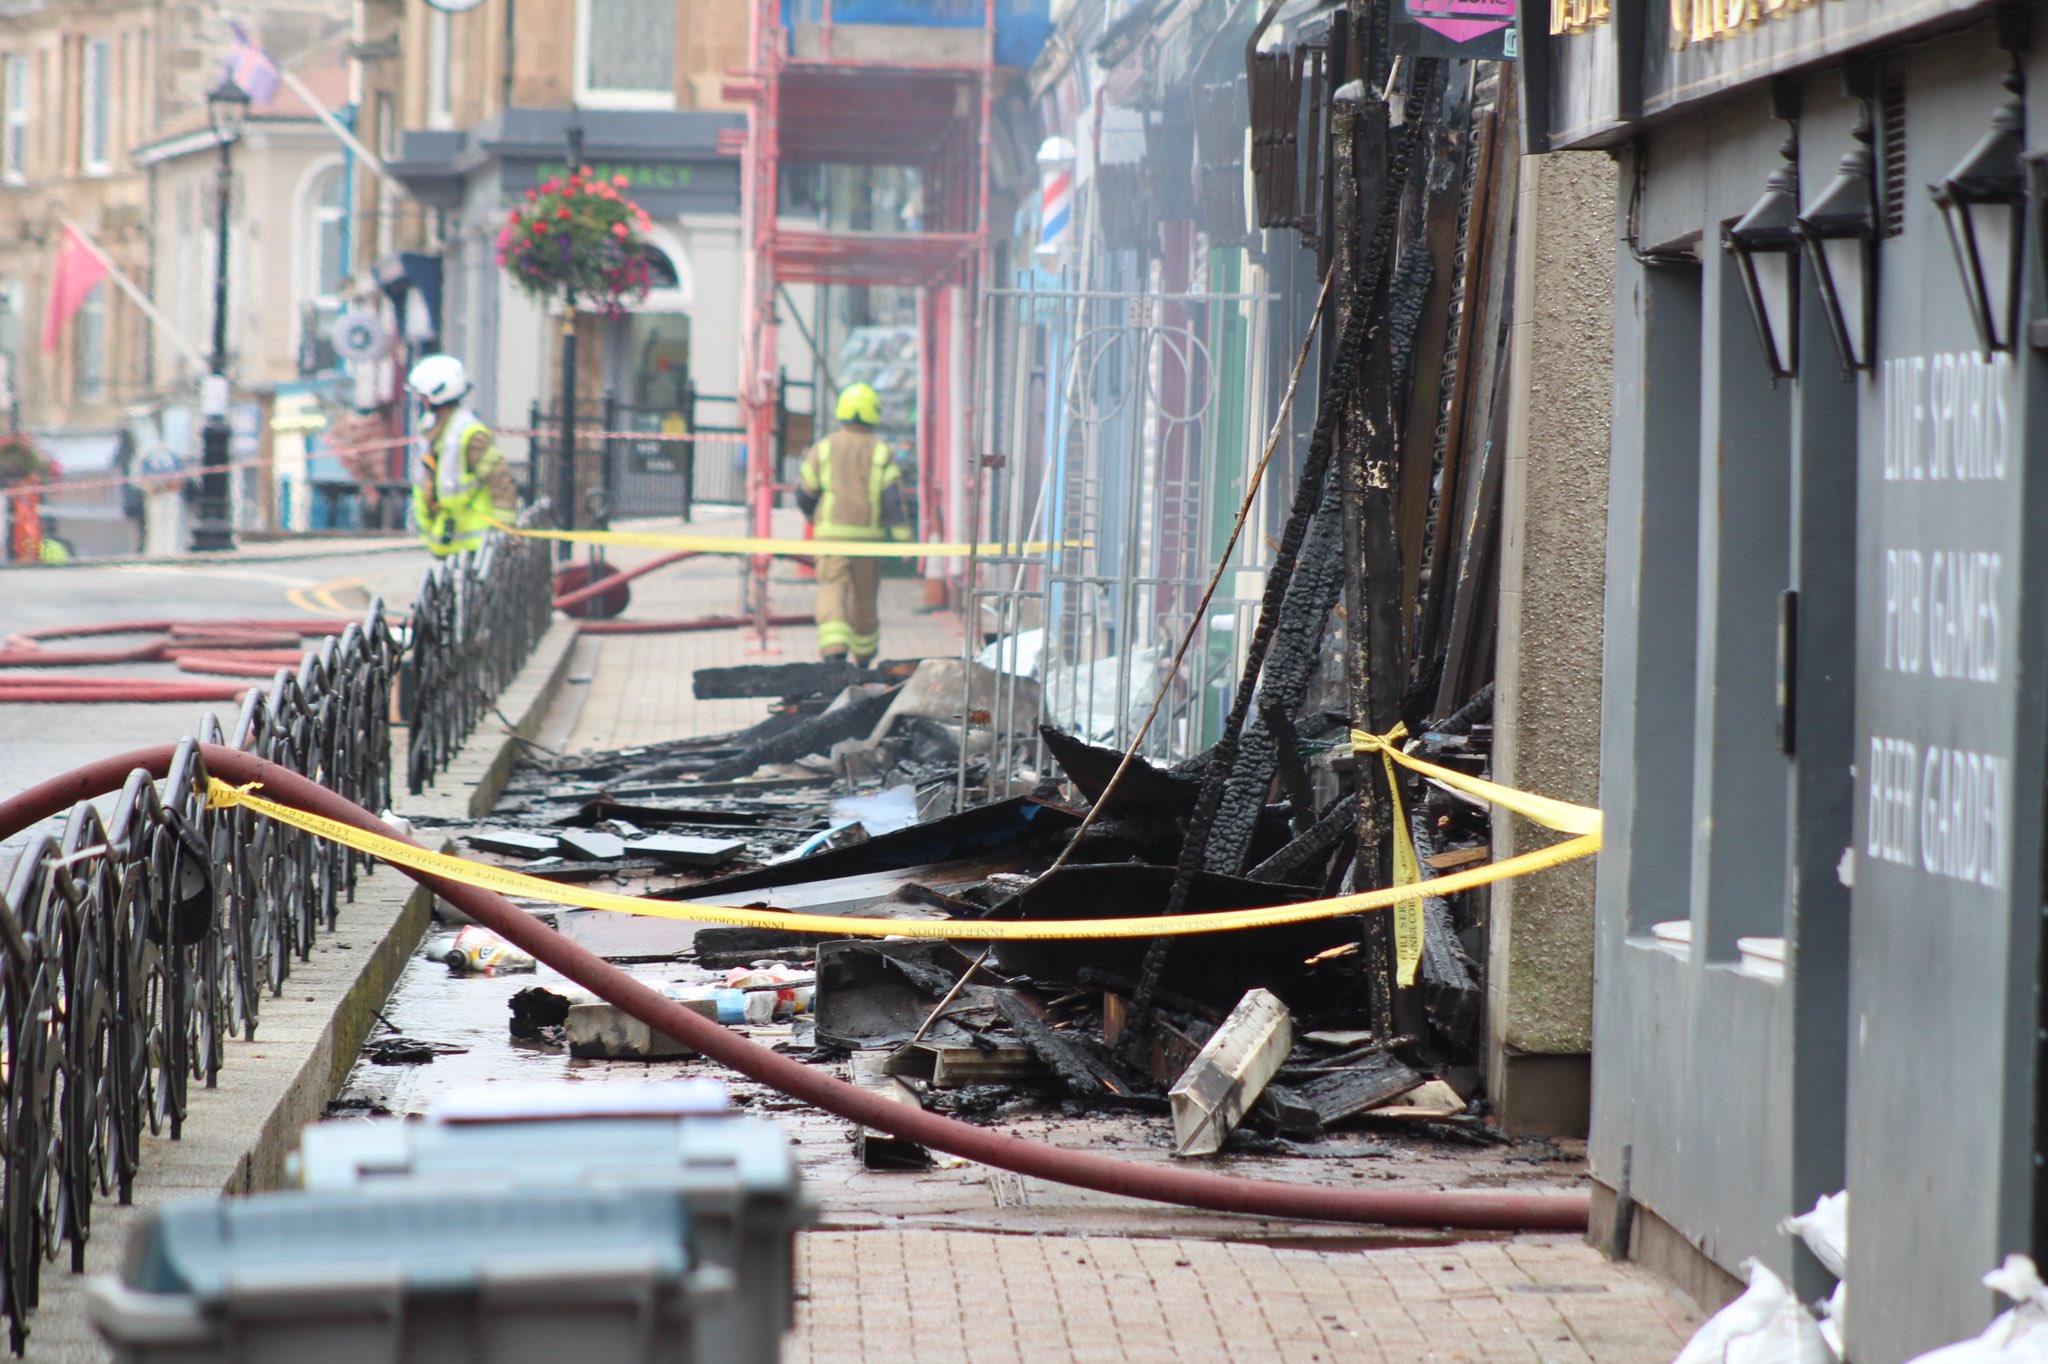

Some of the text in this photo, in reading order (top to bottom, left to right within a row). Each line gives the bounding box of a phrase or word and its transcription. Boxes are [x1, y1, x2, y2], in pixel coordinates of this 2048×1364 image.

[1884, 351, 2008, 480] LIVE SPORTS
[1885, 549, 2001, 682] PUB GAMES
[1868, 737, 1914, 866] BEER
[908, 926, 1003, 937] INNER CORDON
